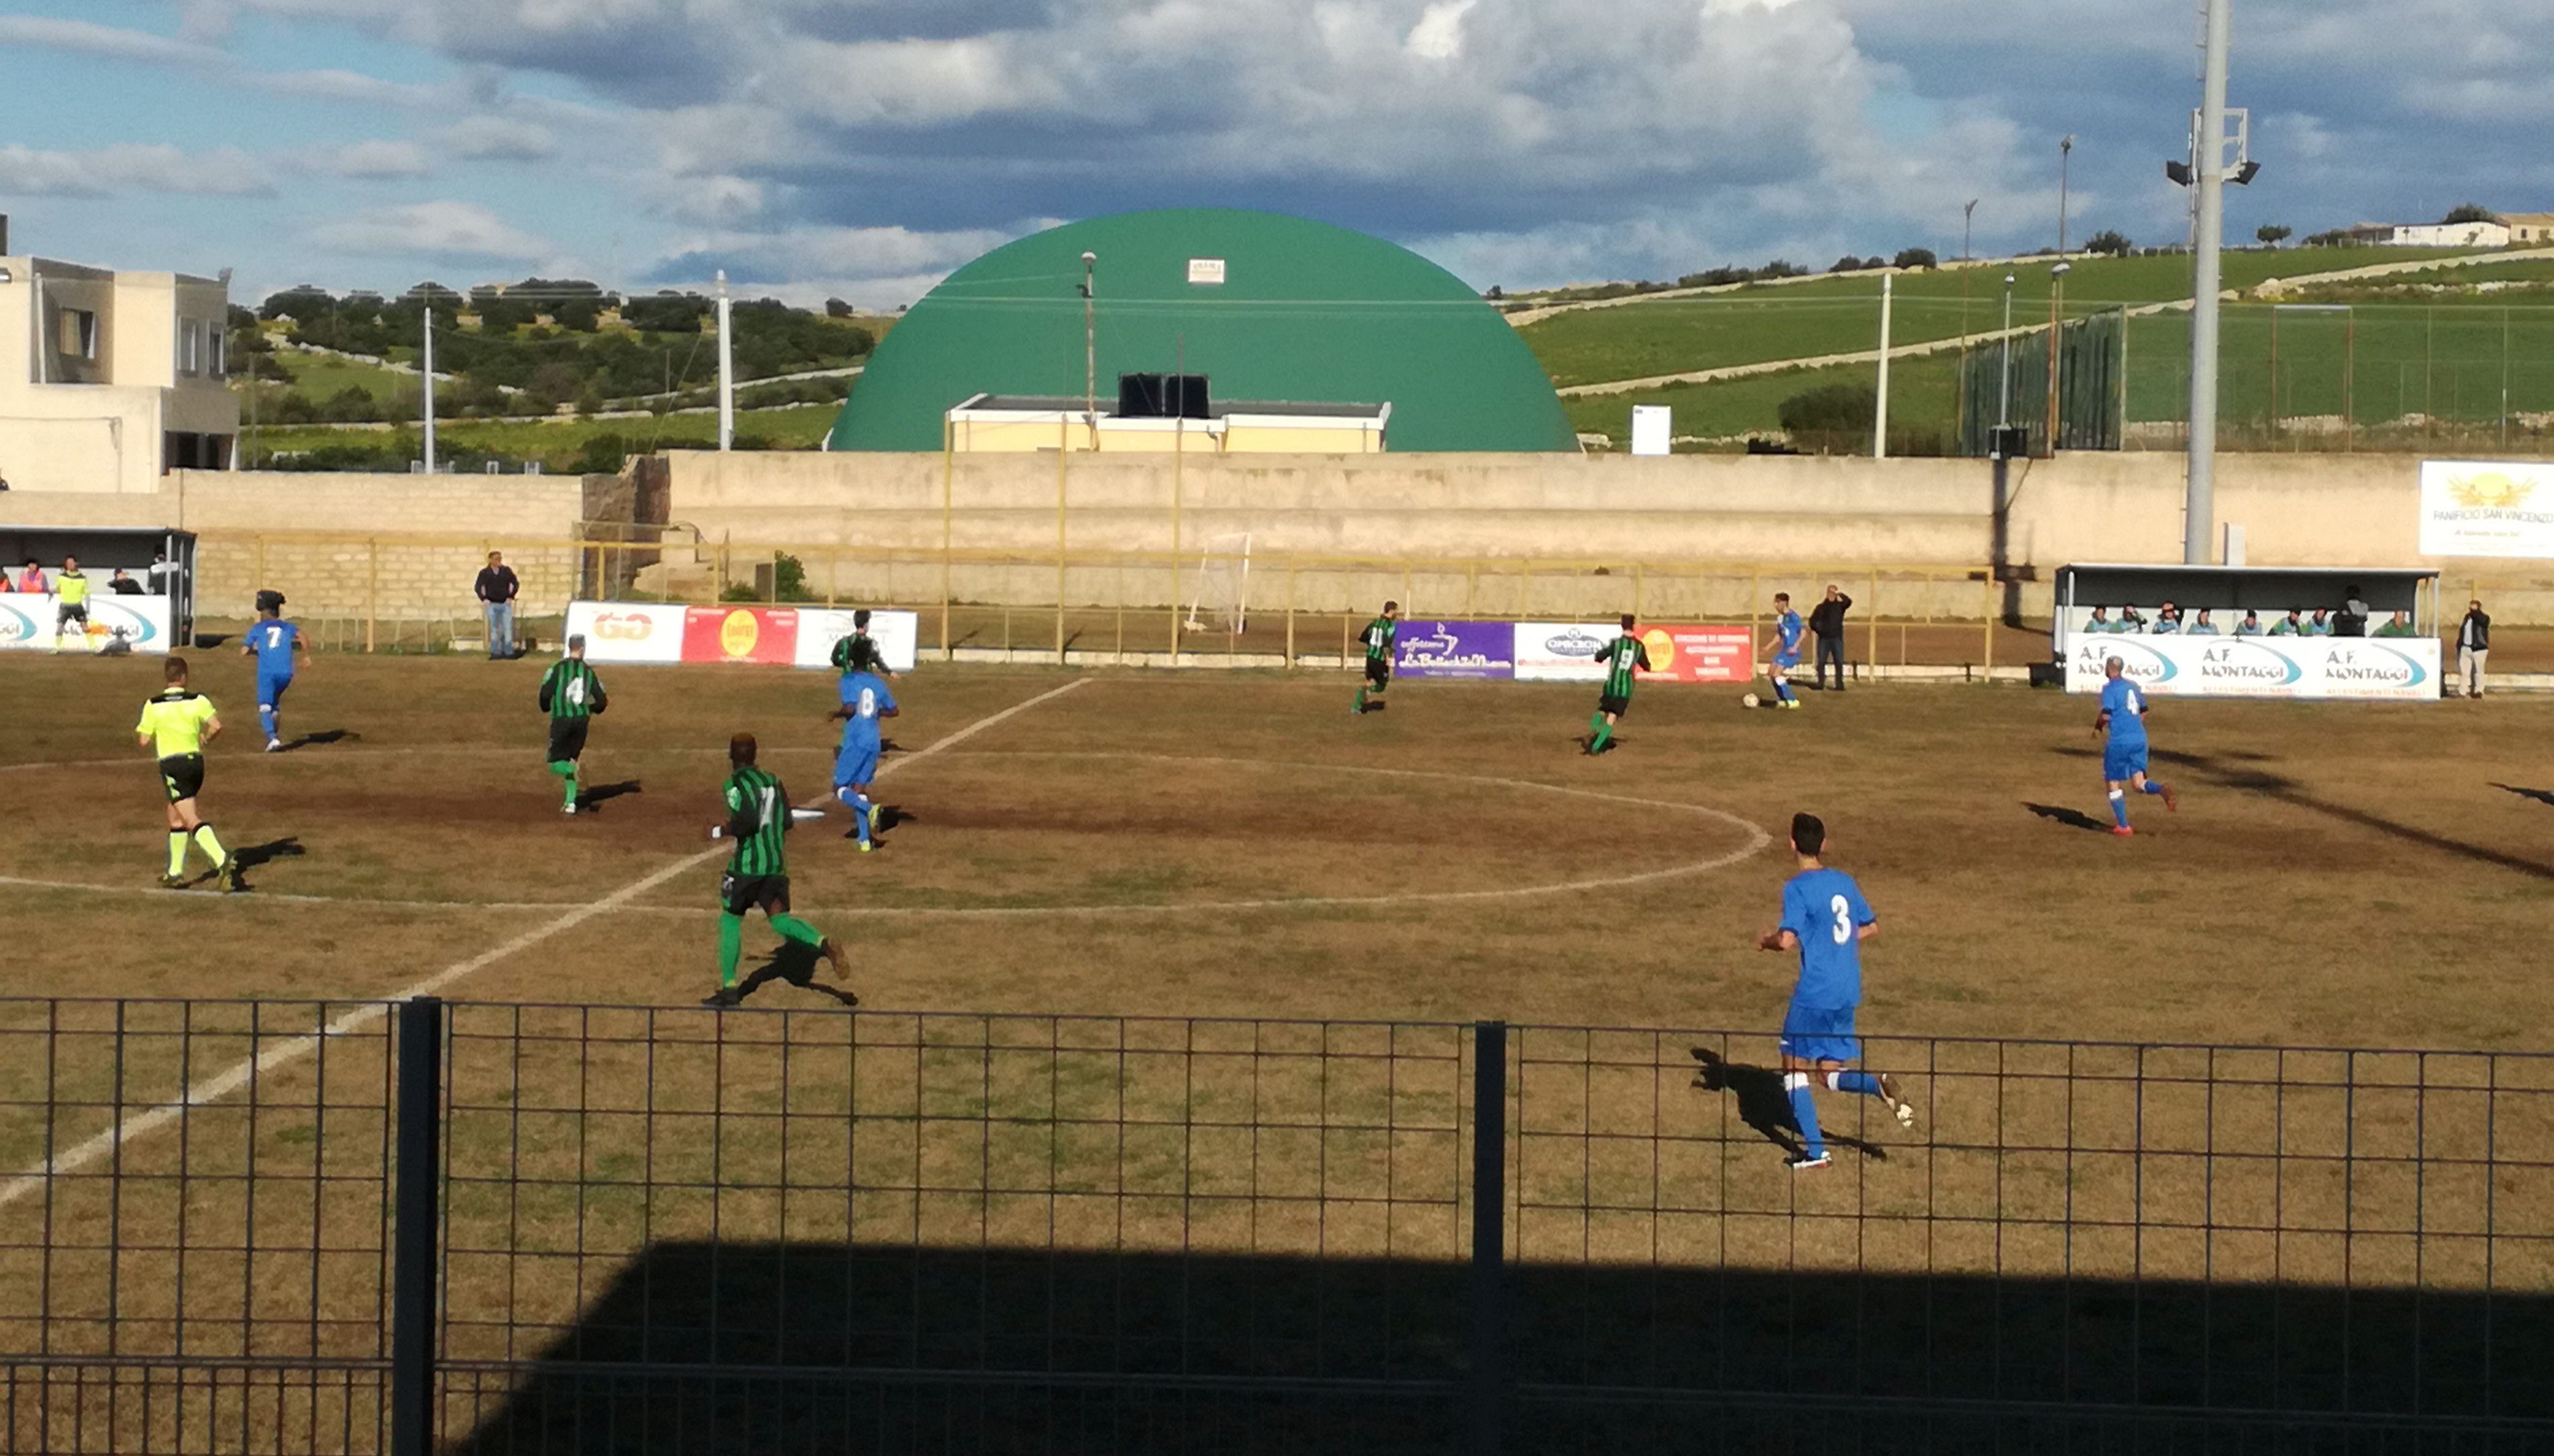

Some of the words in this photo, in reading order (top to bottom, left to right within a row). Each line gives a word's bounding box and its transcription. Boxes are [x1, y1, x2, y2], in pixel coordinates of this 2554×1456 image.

[2433, 510, 2480, 521] PANIFICIO
[2483, 508, 2502, 520] SAN
[2505, 510, 2554, 524] VINCENZO
[266, 626, 282, 648] 7
[2078, 663, 2160, 676] MOAGGI
[2202, 665, 2284, 678] MONTAGGI
[2326, 667, 2409, 680] MONTAGGI
[566, 676, 585, 705] 4
[860, 687, 875, 718] 8
[2127, 688, 2141, 716] 4
[1831, 894, 1851, 945] 3
